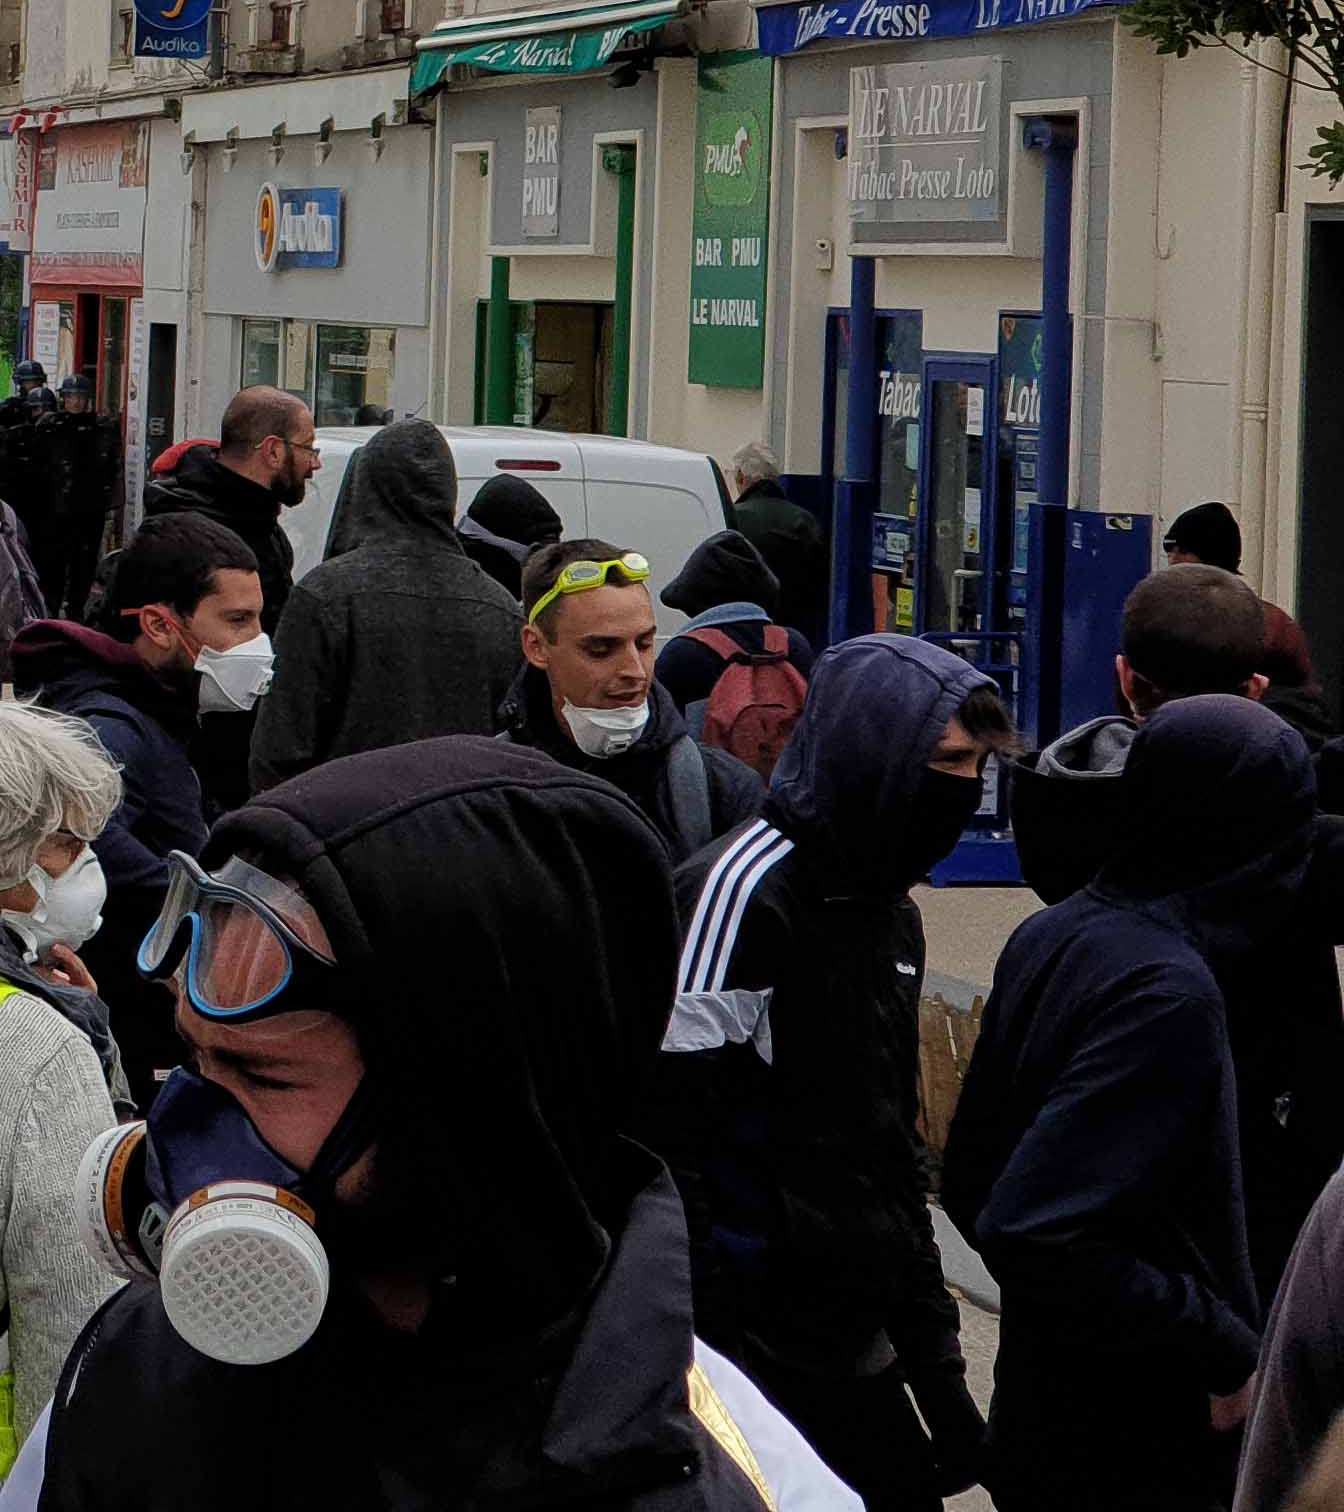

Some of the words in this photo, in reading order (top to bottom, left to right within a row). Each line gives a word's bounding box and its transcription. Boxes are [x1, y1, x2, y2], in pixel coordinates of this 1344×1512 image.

[141, 35, 200, 52] Audika
[511, 33, 577, 67] Narval
[857, 88, 889, 138] LE
[891, 81, 988, 137] NARVAL
[525, 124, 558, 164] BAR
[704, 145, 736, 176] PMU
[15, 132, 28, 232] KASHMIR
[522, 177, 558, 217] PMU
[848, 161, 896, 201] Tabac
[897, 159, 951, 200] Presse
[953, 156, 994, 199] Loto
[696, 238, 722, 266] BAR
[731, 238, 761, 266] PMU
[692, 298, 708, 325] LE
[710, 298, 759, 327] NARVAL
[878, 370, 921, 418] Tabac
